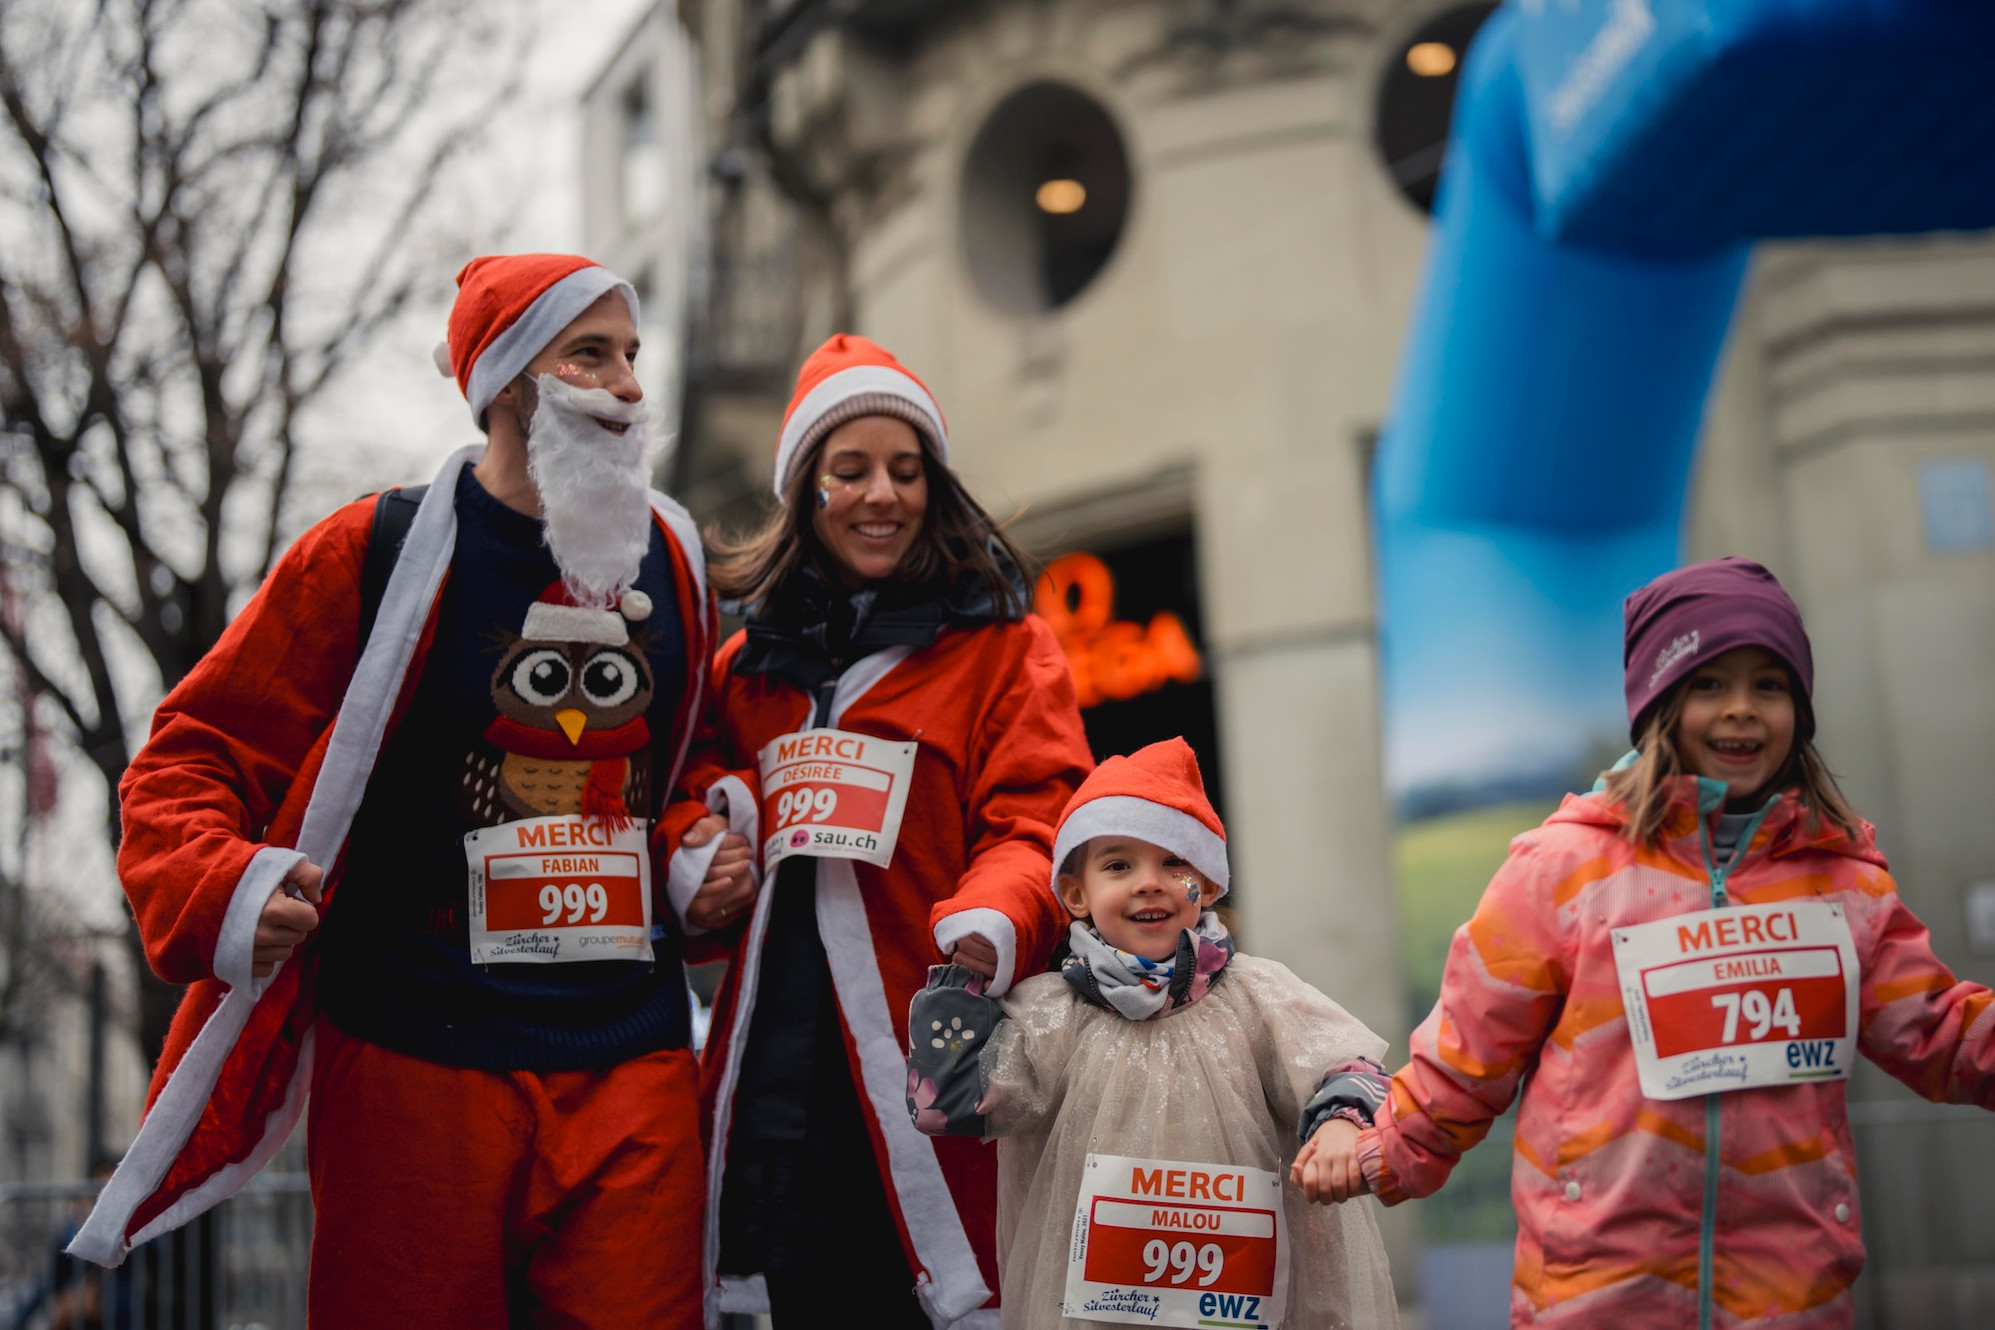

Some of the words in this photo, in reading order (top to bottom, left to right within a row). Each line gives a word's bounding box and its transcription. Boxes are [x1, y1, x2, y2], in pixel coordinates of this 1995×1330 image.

[777, 735, 865, 763] MERCI
[783, 762, 843, 783] DÉSIRÉE
[776, 787, 838, 829] 999
[516, 823, 613, 848] MERCI
[813, 832, 877, 850] sau.ch
[542, 858, 600, 873] FABIAN
[538, 883, 608, 925] 999
[1677, 912, 1799, 953] MERCI
[1713, 958, 1782, 980] EMILIA
[1711, 988, 1801, 1043] 794
[1786, 1041, 1835, 1067] ewz
[1131, 1167, 1244, 1202] MERCI
[1151, 1210, 1221, 1230] MALOU
[1142, 1239, 1224, 1286] 999
[1101, 1288, 1150, 1302] Zürcher
[1199, 1292, 1260, 1320] ewz
[1083, 1299, 1160, 1320] Silvesterlauf
